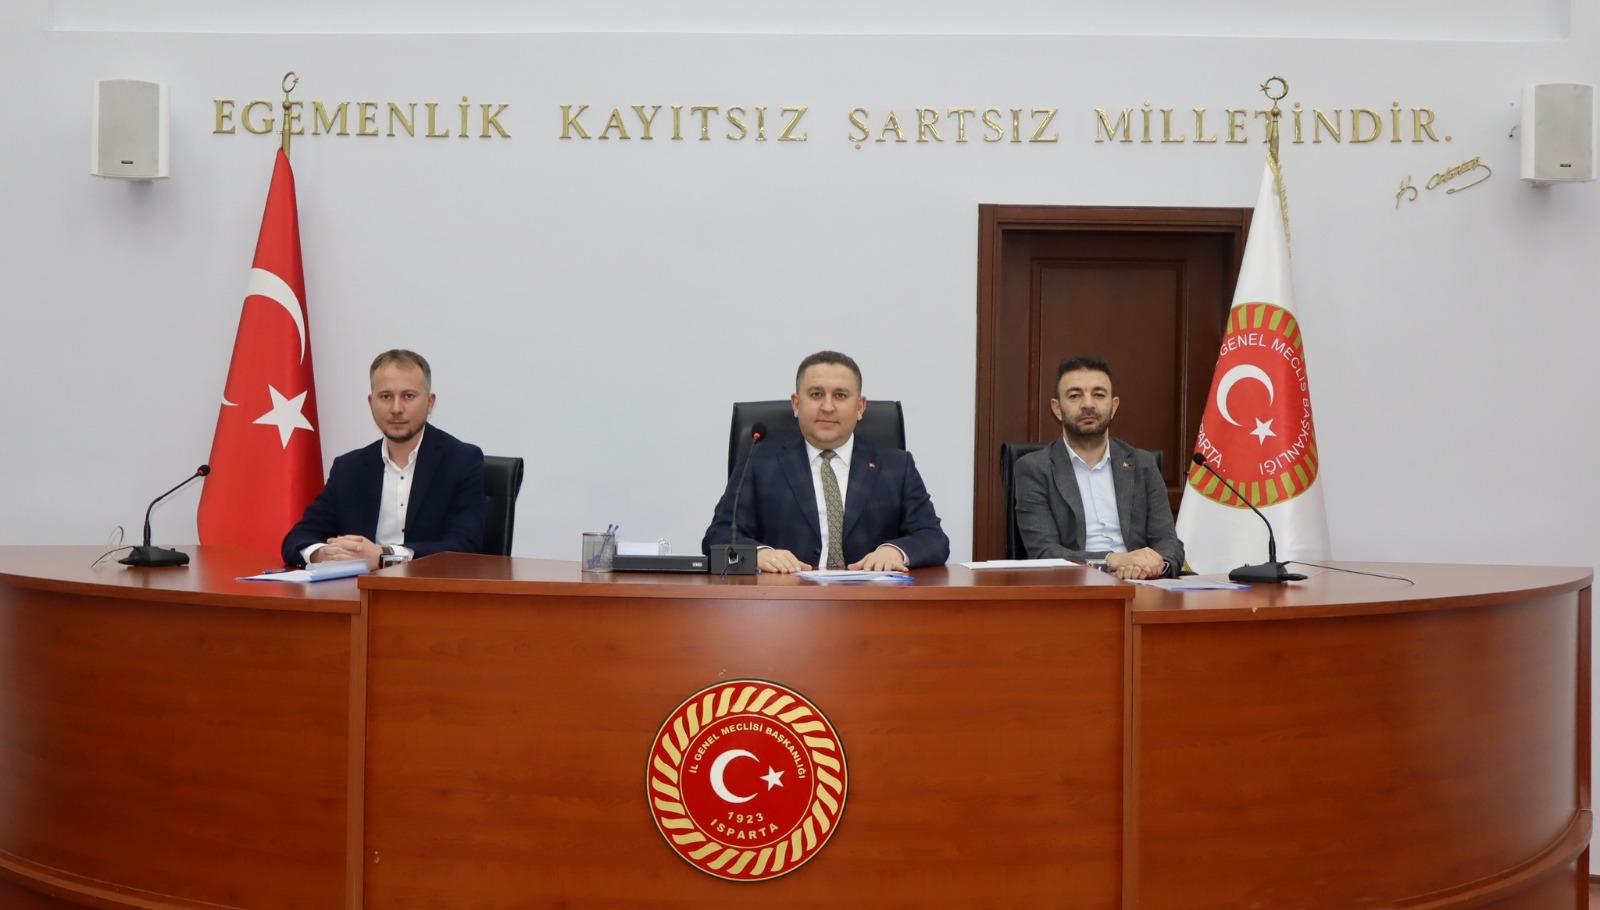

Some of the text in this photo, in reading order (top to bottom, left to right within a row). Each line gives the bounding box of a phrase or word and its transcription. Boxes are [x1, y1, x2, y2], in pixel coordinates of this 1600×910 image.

[213, 96, 1453, 150] EGEMENLİK KAYITSIZ ŞARTSIZ MİLLETİNDİR.
[1220, 332, 1267, 356] GENEL
[1259, 397, 1312, 476] BAŞKANLIĞI
[688, 721, 806, 779] İL GENEL MECLİSİ BAŞKANLIĞI
[710, 818, 779, 840] ISPARTA
[727, 811, 764, 824] 1923
